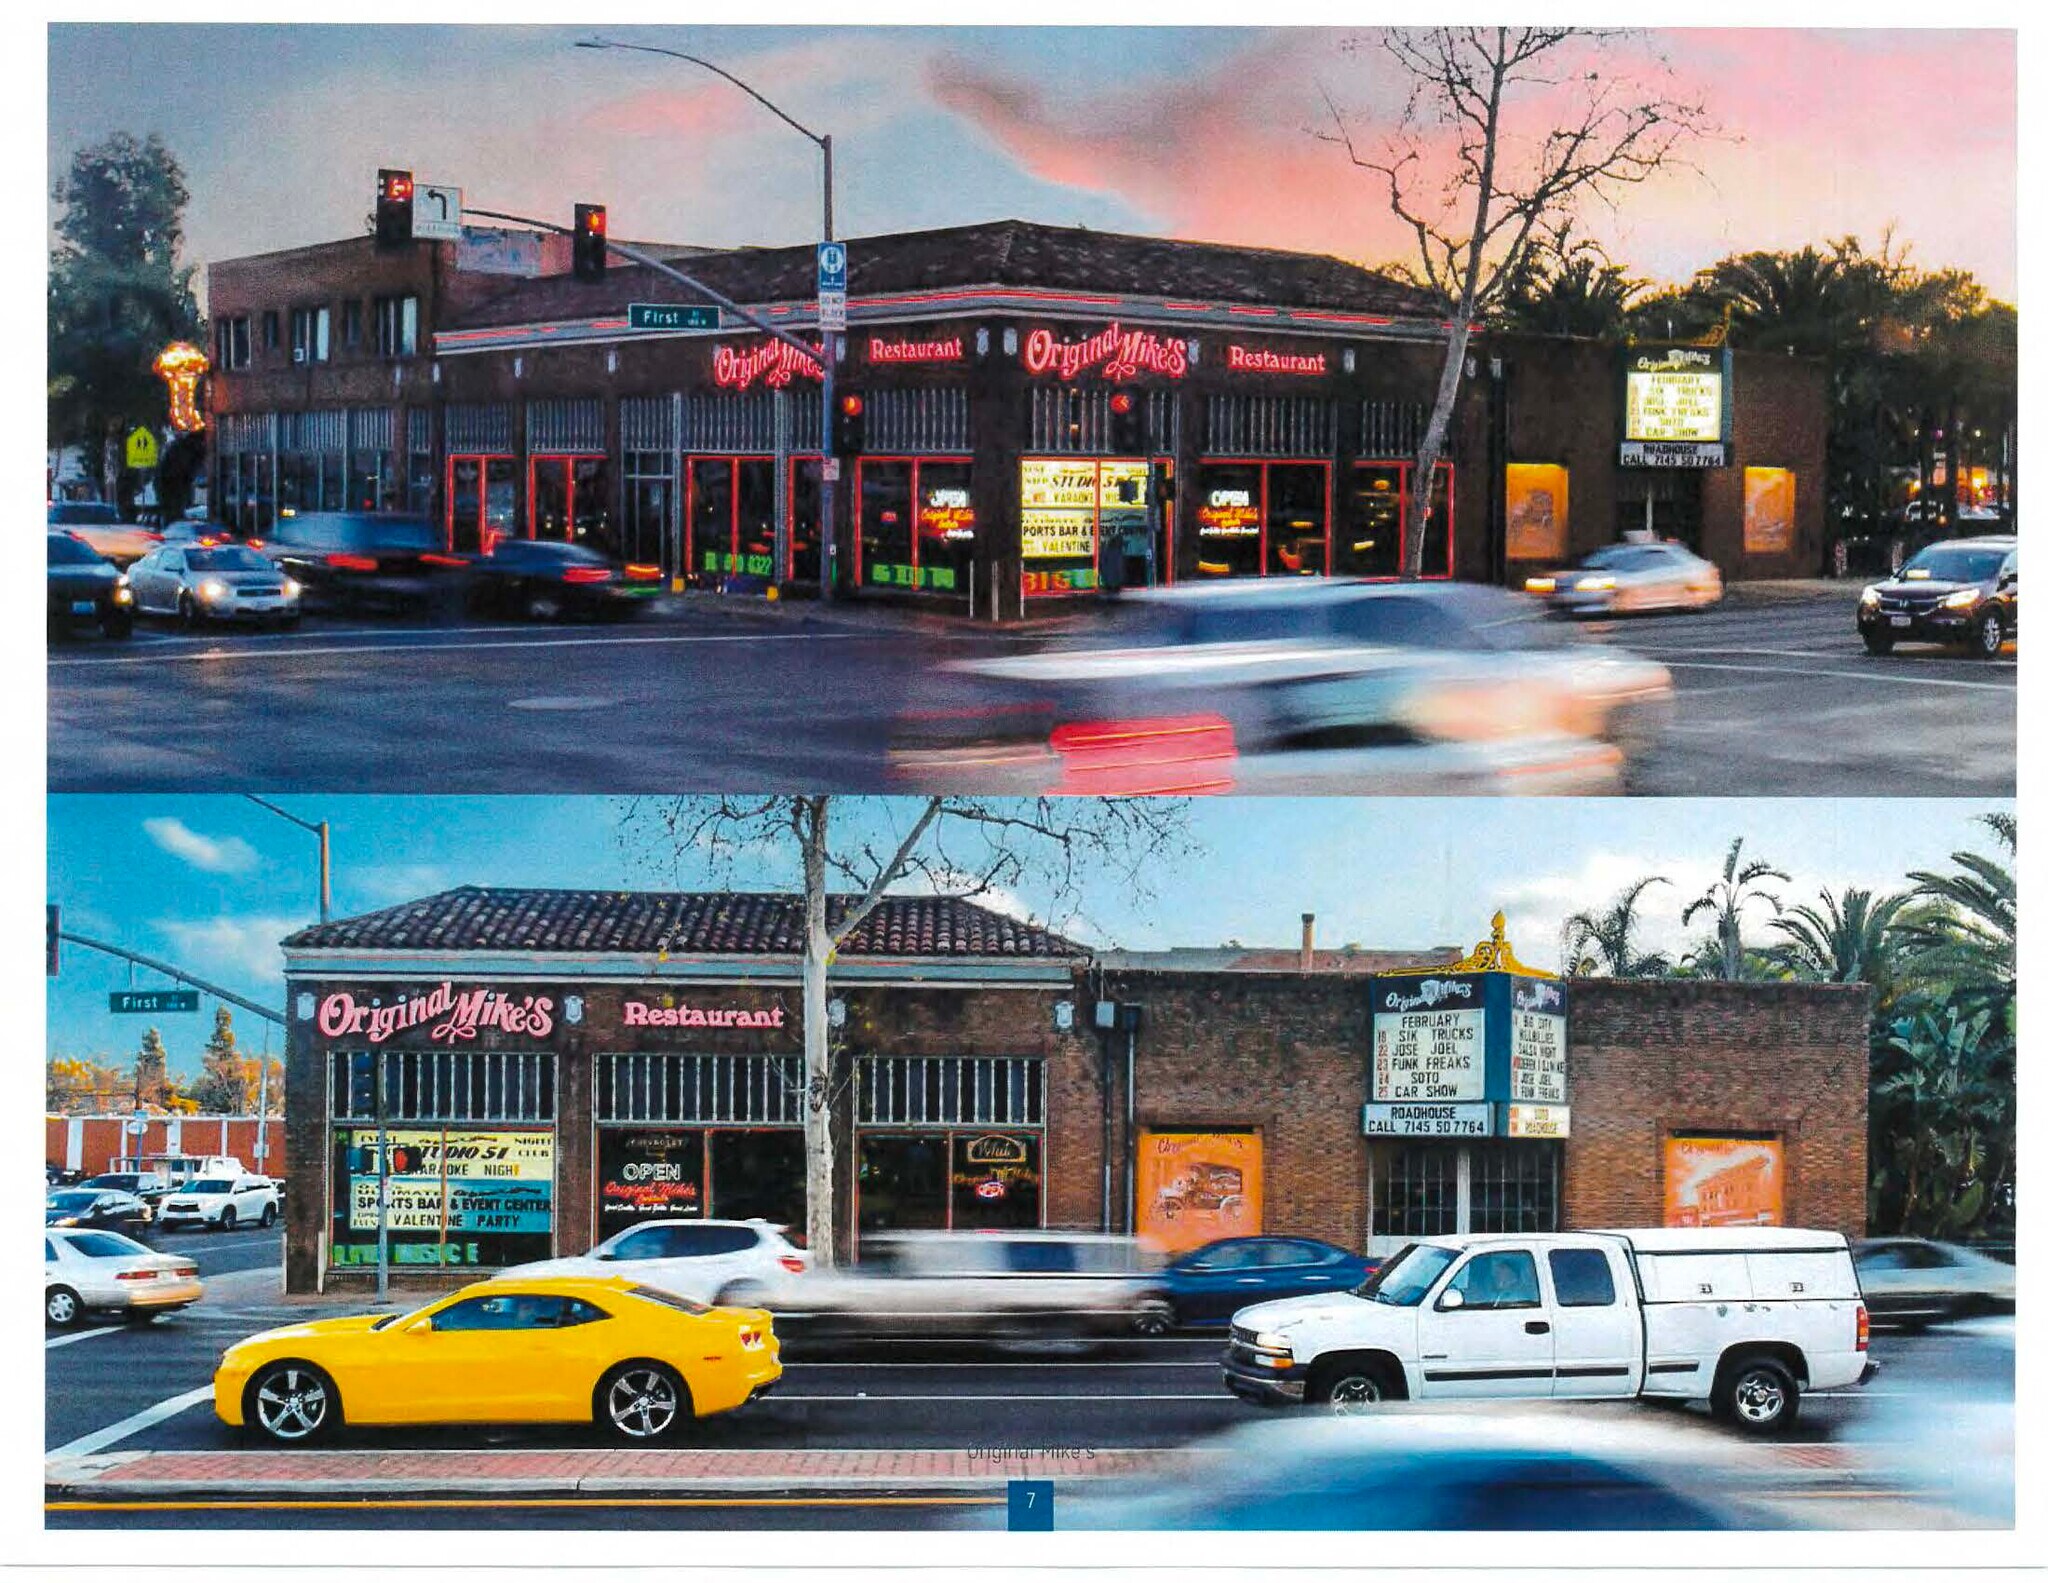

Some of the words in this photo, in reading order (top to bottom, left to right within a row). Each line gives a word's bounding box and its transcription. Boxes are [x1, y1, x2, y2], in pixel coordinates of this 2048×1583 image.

[643, 310, 678, 324] First
[870, 339, 962, 361] Restaurant
[1027, 321, 1121, 377] Original
[1105, 330, 1187, 379] Mike's
[714, 337, 779, 389] Original
[1230, 346, 1326, 373] Restaurant
[1023, 526, 1056, 536] PORTS
[1059, 526, 1079, 536] BAR
[123, 996, 157, 1009] First
[319, 981, 452, 1043] Original
[431, 989, 555, 1044] Mike's
[623, 1002, 784, 1028] Restaurant
[1402, 1013, 1460, 1028] FEBRUARY
[1399, 1029, 1417, 1042] SIK
[1432, 1027, 1474, 1041] TRUCKS
[1392, 1043, 1418, 1057] JOSE
[1431, 1042, 1458, 1055] JOEL
[1392, 1057, 1419, 1071] FUNK
[1426, 1055, 1471, 1070] FREAKS
[1410, 1071, 1440, 1085] SOTO
[1395, 1085, 1418, 1098] CAR
[1426, 1083, 1458, 1098] SHOW
[1391, 1106, 1457, 1120] ROADHOUSE
[1368, 1120, 1396, 1133] CALL
[1405, 1120, 1431, 1133] 7145
[419, 1146, 480, 1159] TUDIO
[418, 1163, 469, 1177] ARAOKE
[483, 1162, 521, 1177] NIGHT
[623, 1163, 681, 1181] OPEN
[357, 1196, 413, 1209] SPRTS
[449, 1198, 459, 1210] &
[461, 1198, 500, 1211] EVENT
[393, 1213, 462, 1227] VALENTNE
[476, 1214, 520, 1228] PARTY
